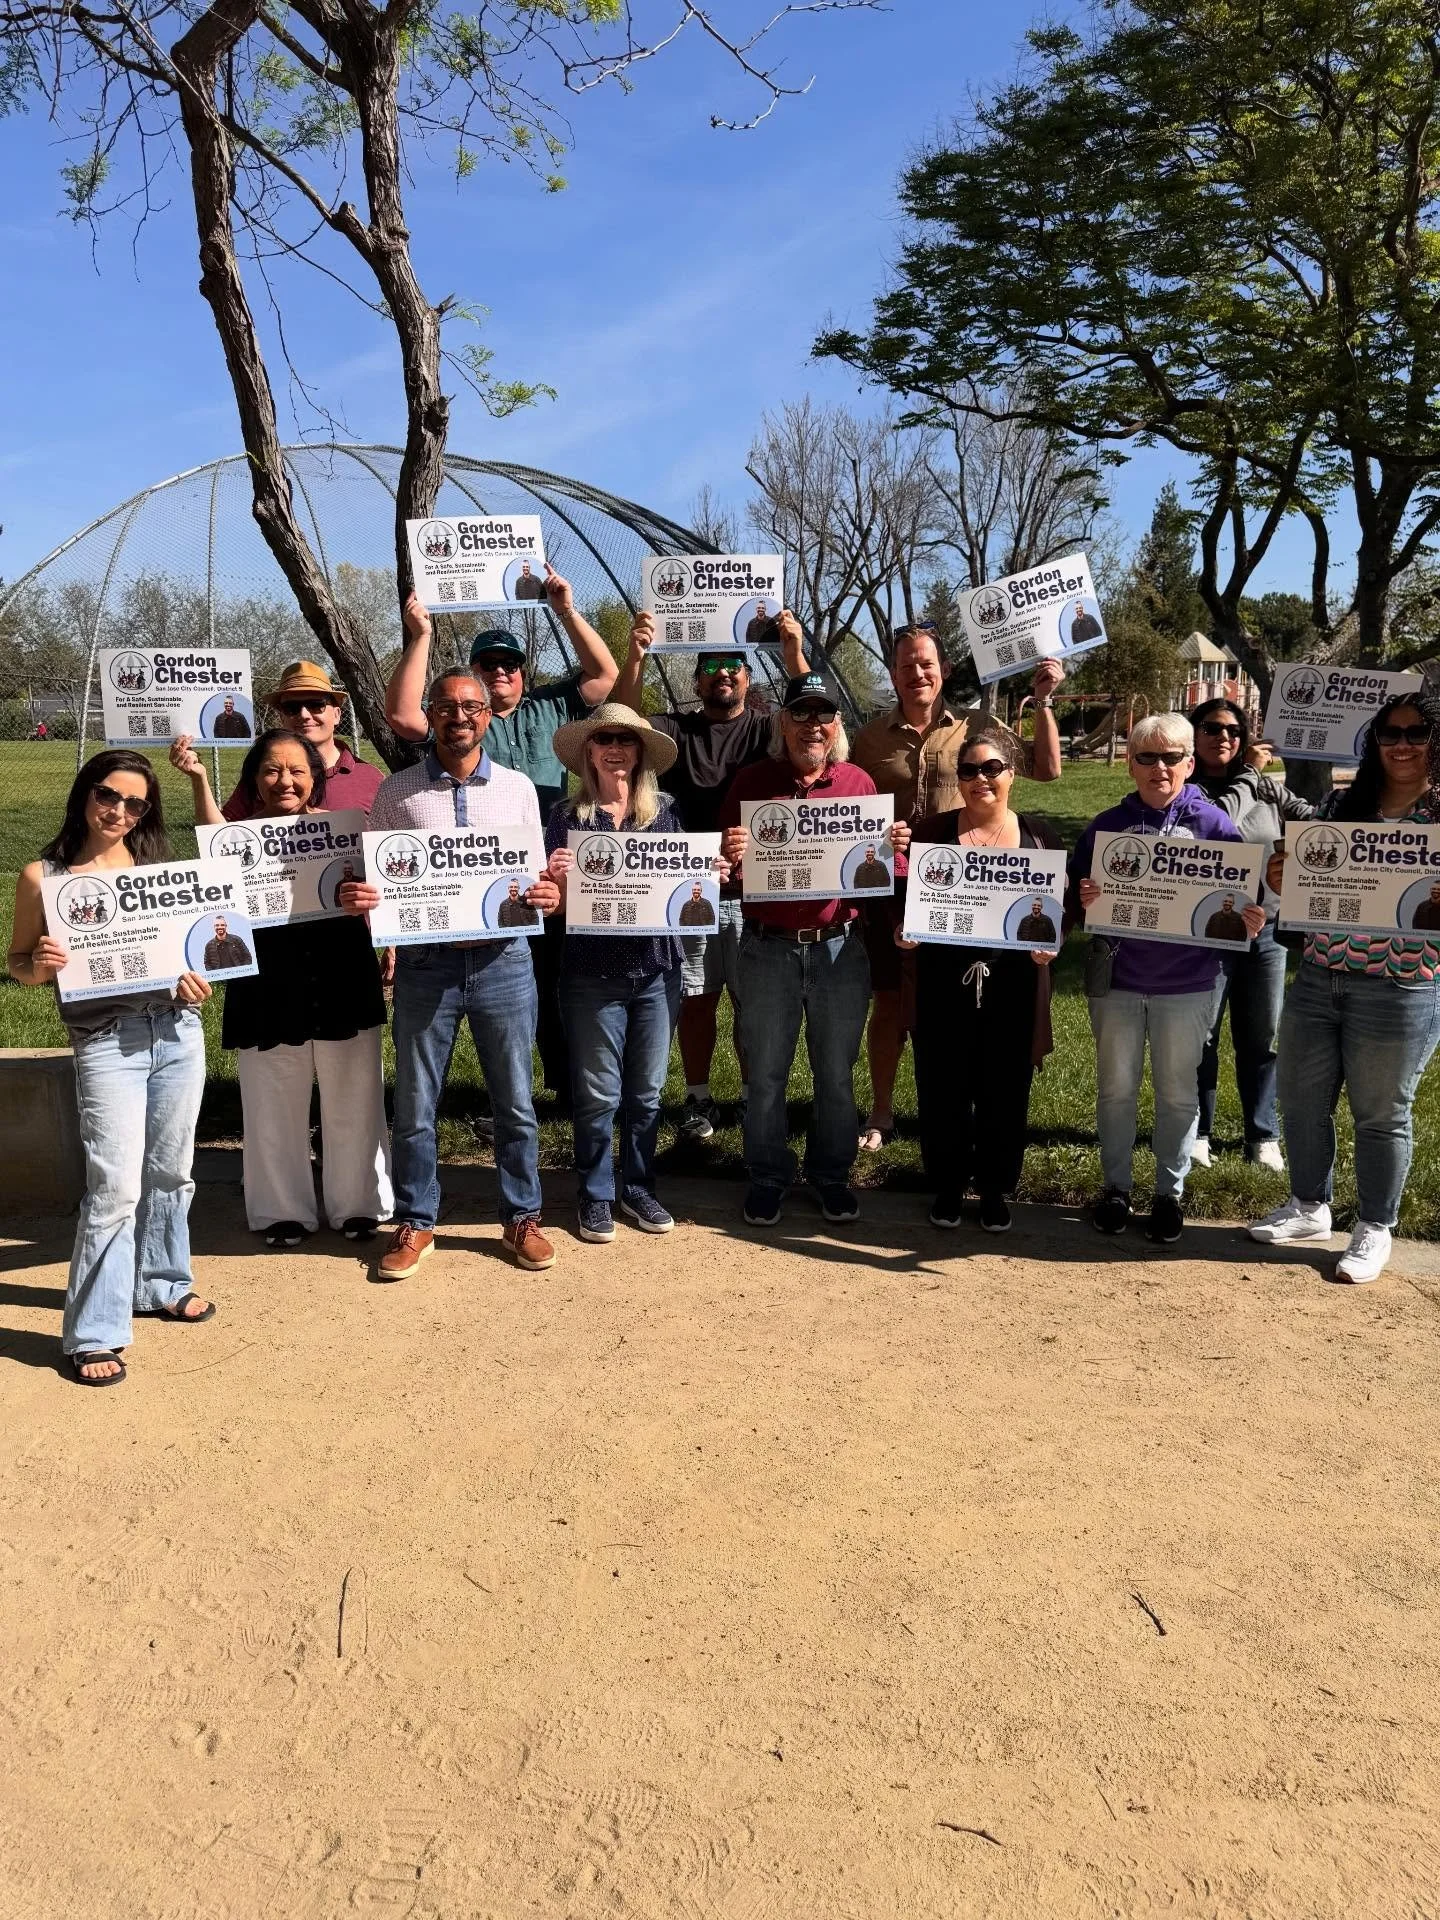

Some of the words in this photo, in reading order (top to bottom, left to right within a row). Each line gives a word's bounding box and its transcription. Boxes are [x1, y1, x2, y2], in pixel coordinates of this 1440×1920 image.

[457, 520, 513, 535] Gordon
[459, 533, 536, 551] Chester
[692, 559, 751, 574] Gordon
[693, 572, 775, 590] Chester
[1007, 569, 1062, 594] Gordon
[1011, 575, 1084, 609] Chester
[153, 653, 216, 667] Gordon
[154, 666, 242, 684] Chester
[1327, 671, 1388, 690] Gordon
[1324, 684, 1400, 707] Cheste
[797, 802, 861, 819] Gordon
[260, 820, 331, 839] Gordon
[797, 816, 886, 836] Chester
[263, 832, 359, 857] Chester
[427, 832, 499, 850] Gordon
[624, 837, 689, 853] Gordon
[1350, 828, 1428, 846] Gordon
[429, 847, 528, 870] Chester
[624, 851, 713, 870] Chester
[771, 849, 788, 857] Safe,
[965, 850, 1030, 868] Gordon
[1153, 841, 1224, 862] Gordon
[1349, 843, 1440, 867] Cheste
[243, 873, 257, 881] afe,
[964, 864, 1056, 886] Chester
[1151, 855, 1251, 882] Chester
[114, 869, 199, 892] Gordon
[244, 878, 265, 888] silient
[1162, 876, 1177, 884] Jose
[1177, 878, 1190, 886] City
[1217, 881, 1242, 890] District
[1311, 881, 1343, 889] Resilient
[1343, 882, 1358, 890] San
[1358, 883, 1376, 891] Jose
[1317, 875, 1336, 883] Safe,
[118, 882, 233, 913] Chester
[397, 891, 428, 899] Resilient
[442, 889, 460, 897] Jose
[402, 885, 421, 893] Safe,
[936, 891, 952, 900] Safe,
[1115, 889, 1144, 898] Resilient
[1144, 891, 1157, 899] San
[1157, 893, 1174, 901] Jose
[1120, 883, 1138, 892] Safe,
[1138, 885, 1178, 896] Sustainable,
[931, 897, 958, 905] Resilient
[121, 915, 136, 923] San
[137, 913, 154, 921] Jose
[154, 911, 170, 919] City
[202, 902, 229, 912] District
[69, 942, 85, 951] and
[85, 938, 121, 949] Resilient
[121, 936, 137, 944] San
[137, 934, 158, 942] Jose
[83, 934, 90, 942] A
[90, 932, 111, 941] Safe,
